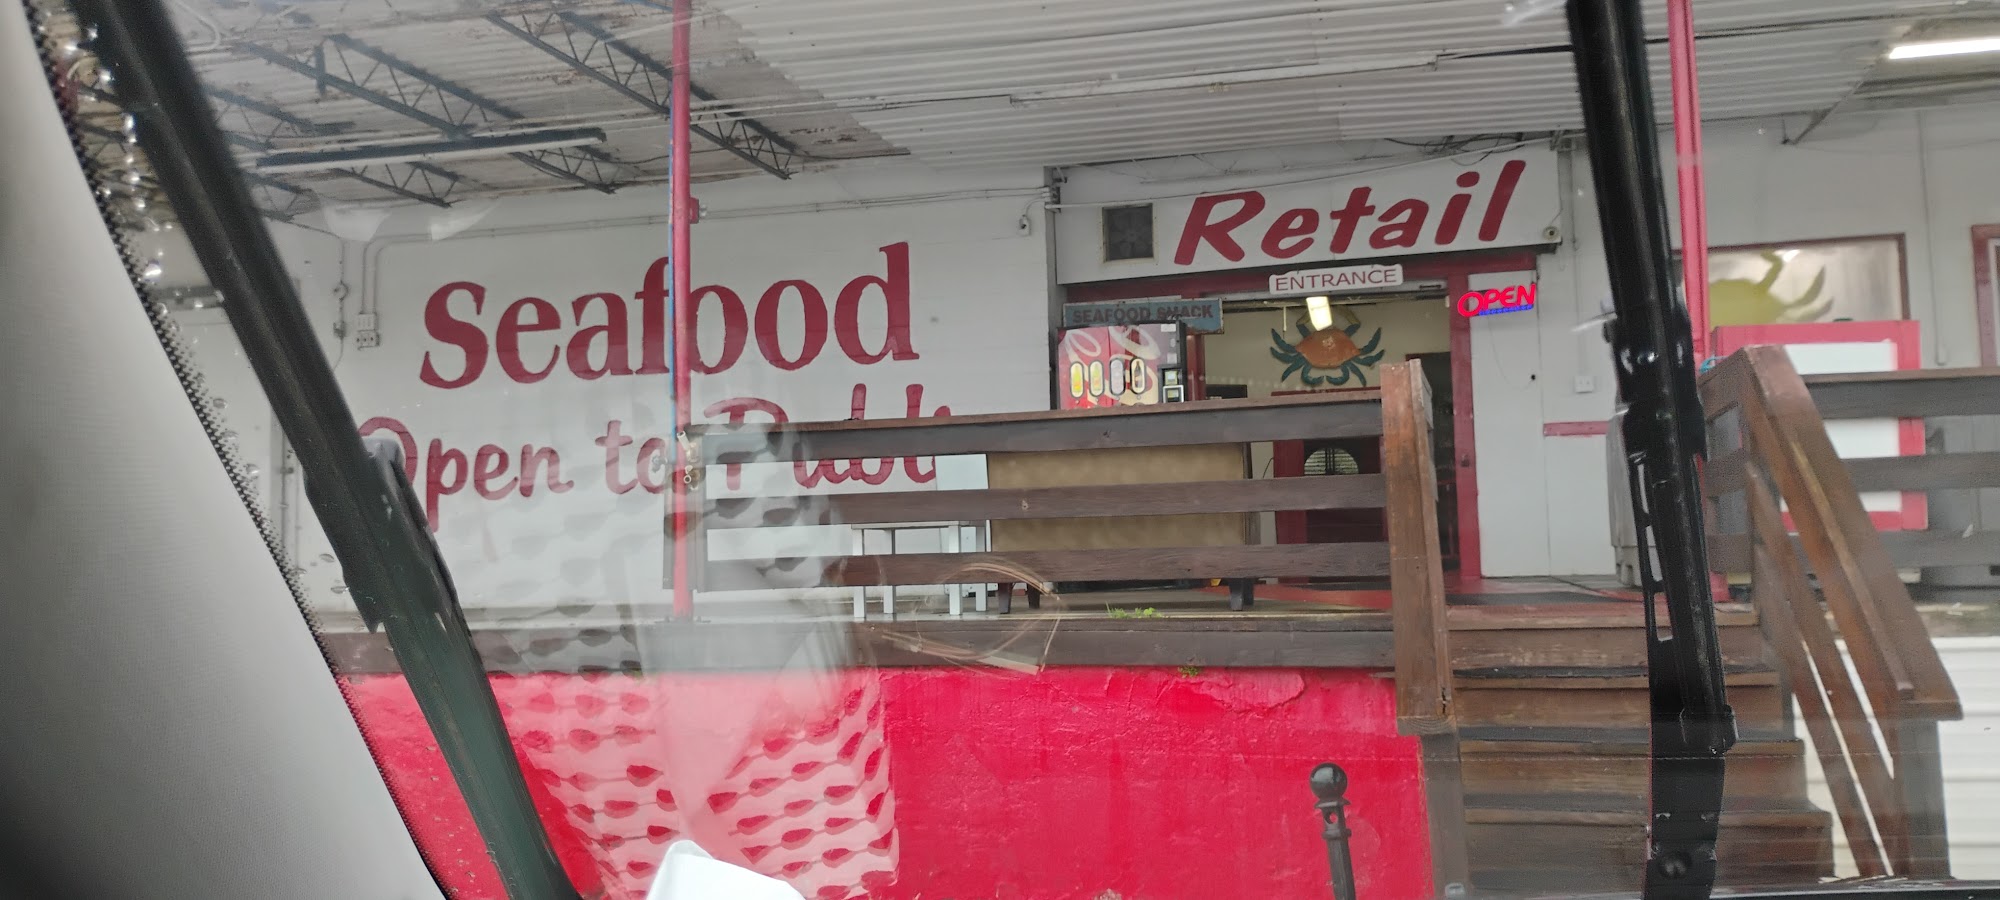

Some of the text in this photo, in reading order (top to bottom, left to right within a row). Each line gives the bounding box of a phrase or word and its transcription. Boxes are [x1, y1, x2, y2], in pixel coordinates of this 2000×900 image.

[1174, 160, 1525, 266] Retail
[1275, 268, 1398, 292] ENTRANCE
[1457, 283, 1537, 318] OPEN
[419, 241, 920, 389] Seafood
[1072, 307, 1150, 324] SEAFOOD
[595, 419, 672, 496] to
